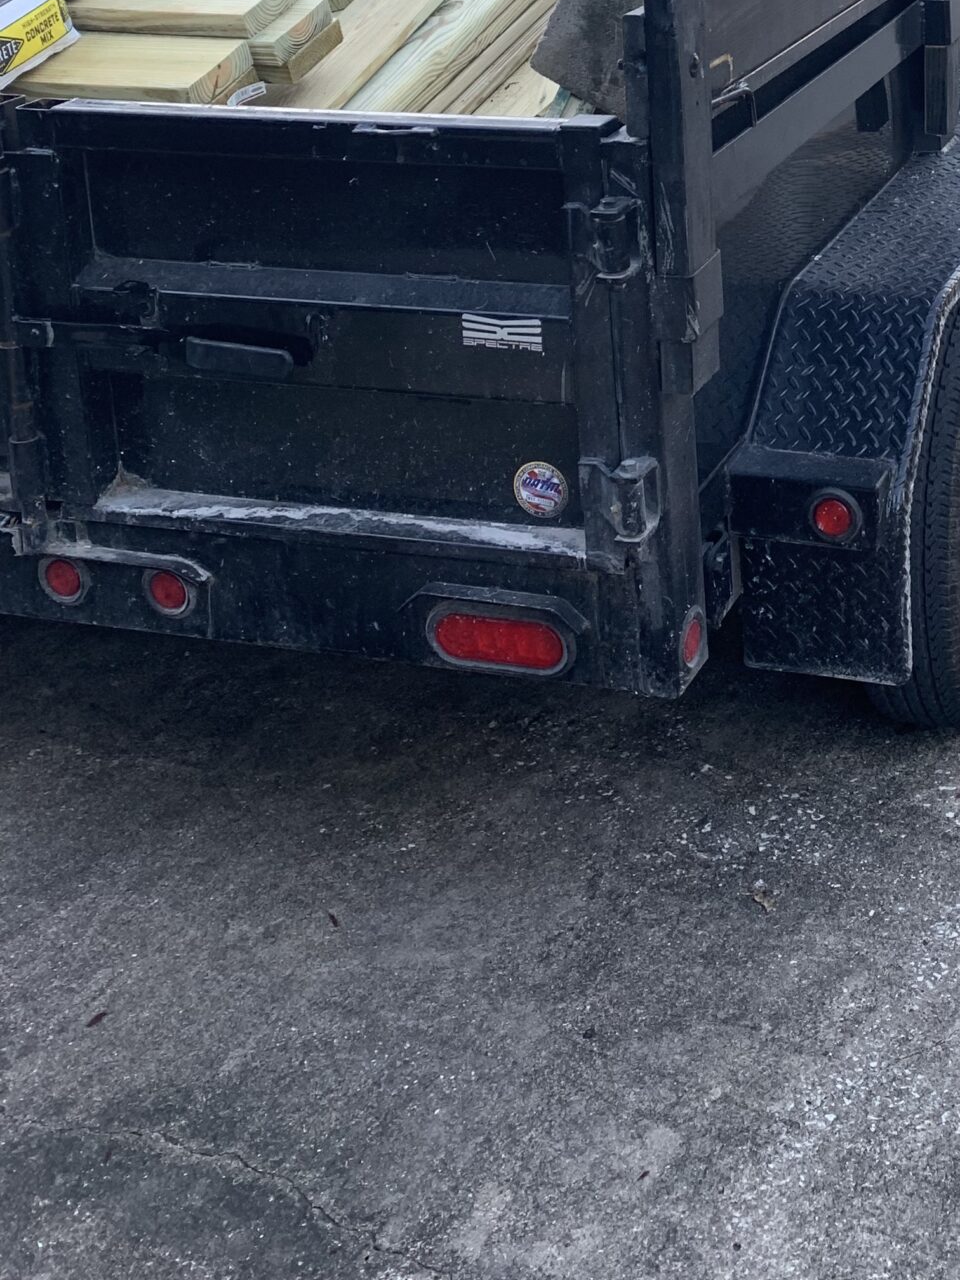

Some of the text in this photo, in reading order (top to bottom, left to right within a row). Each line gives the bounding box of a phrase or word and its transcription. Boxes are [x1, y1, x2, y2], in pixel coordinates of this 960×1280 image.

[25, 11, 60, 42] CONCRETE
[40, 30, 55, 46] MIX
[463, 338, 543, 352] SPECTRE
